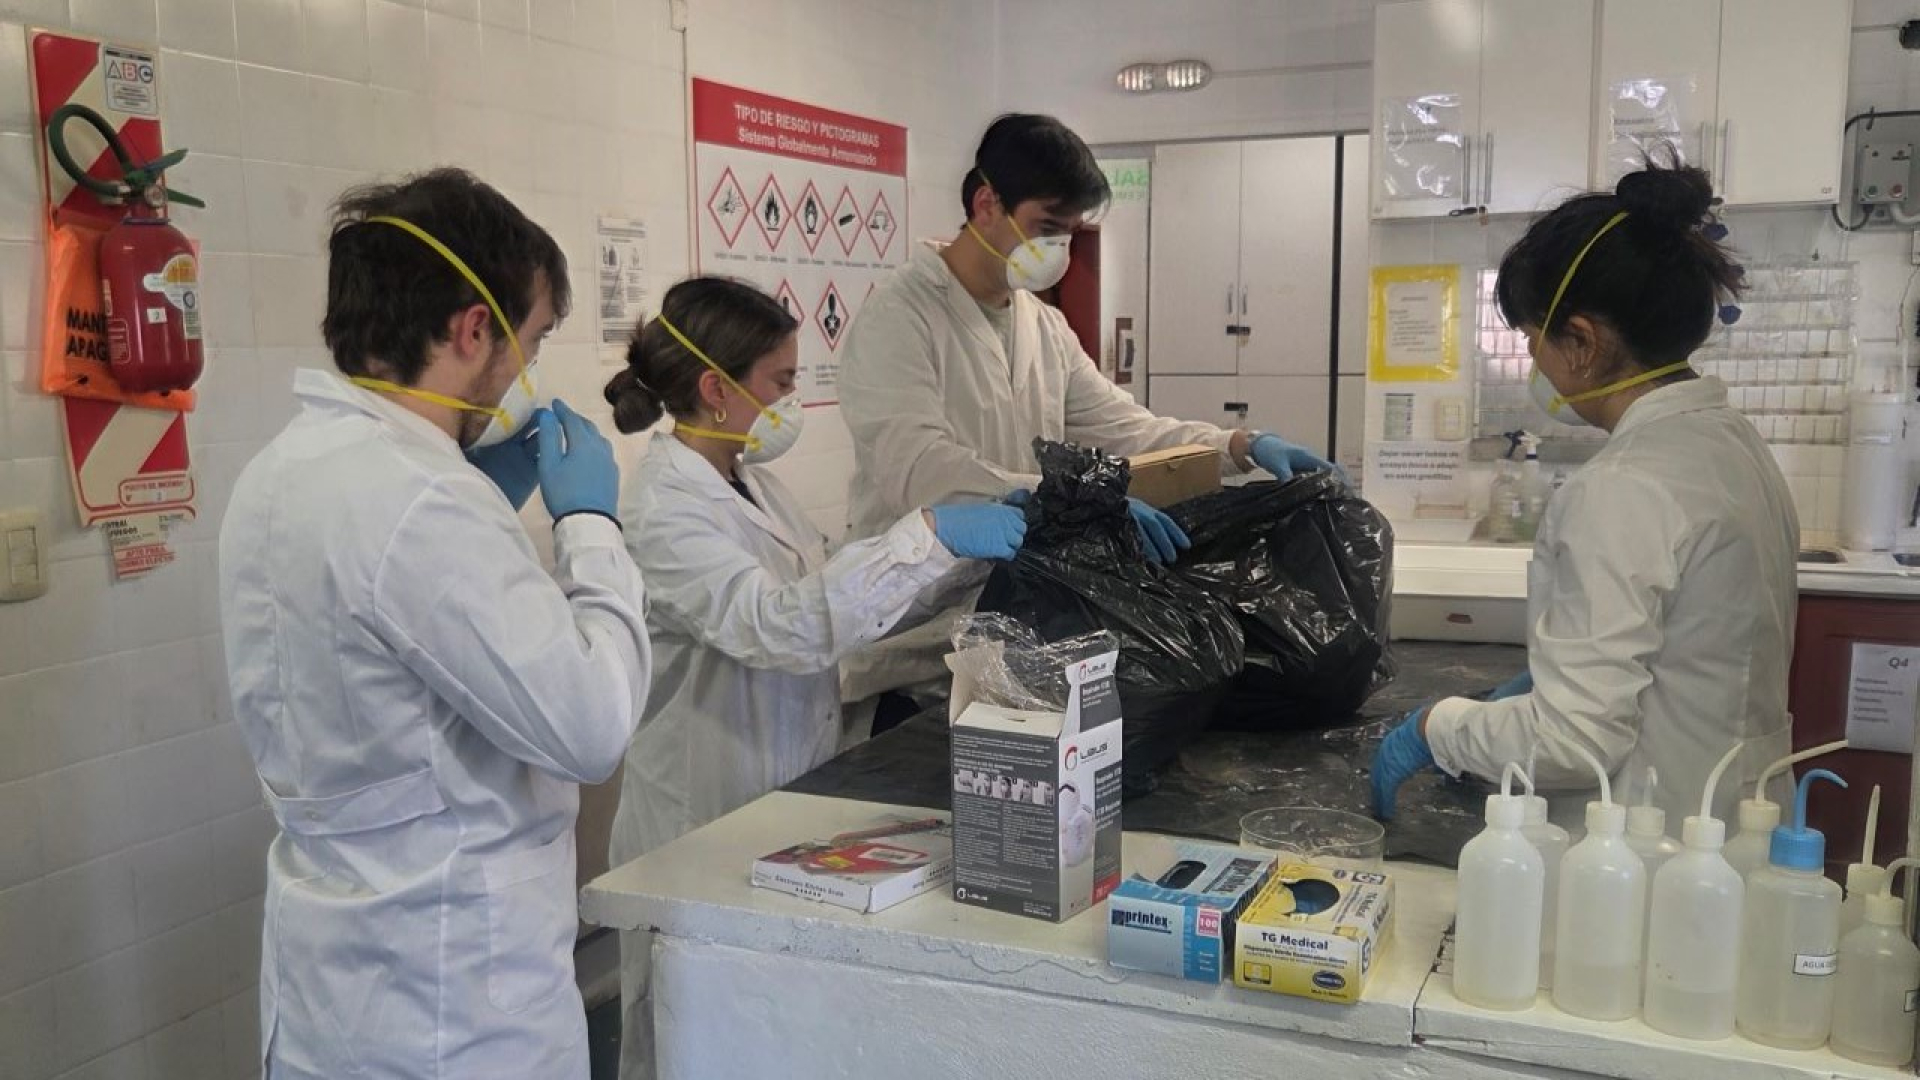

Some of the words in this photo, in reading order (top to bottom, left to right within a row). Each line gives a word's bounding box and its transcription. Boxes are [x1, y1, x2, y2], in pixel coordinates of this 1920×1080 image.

[734, 104, 758, 124] TIPO
[760, 110, 775, 126] DE
[776, 113, 811, 134] RIESGO
[812, 122, 819, 136] Y
[820, 122, 880, 148] PICTOGRAMAS
[738, 127, 776, 147] Sistema
[778, 134, 830, 158] Globalmente
[1200, 917, 1218, 928] 100
[1262, 932, 1277, 943] TG
[1281, 934, 1329, 951] Medical
